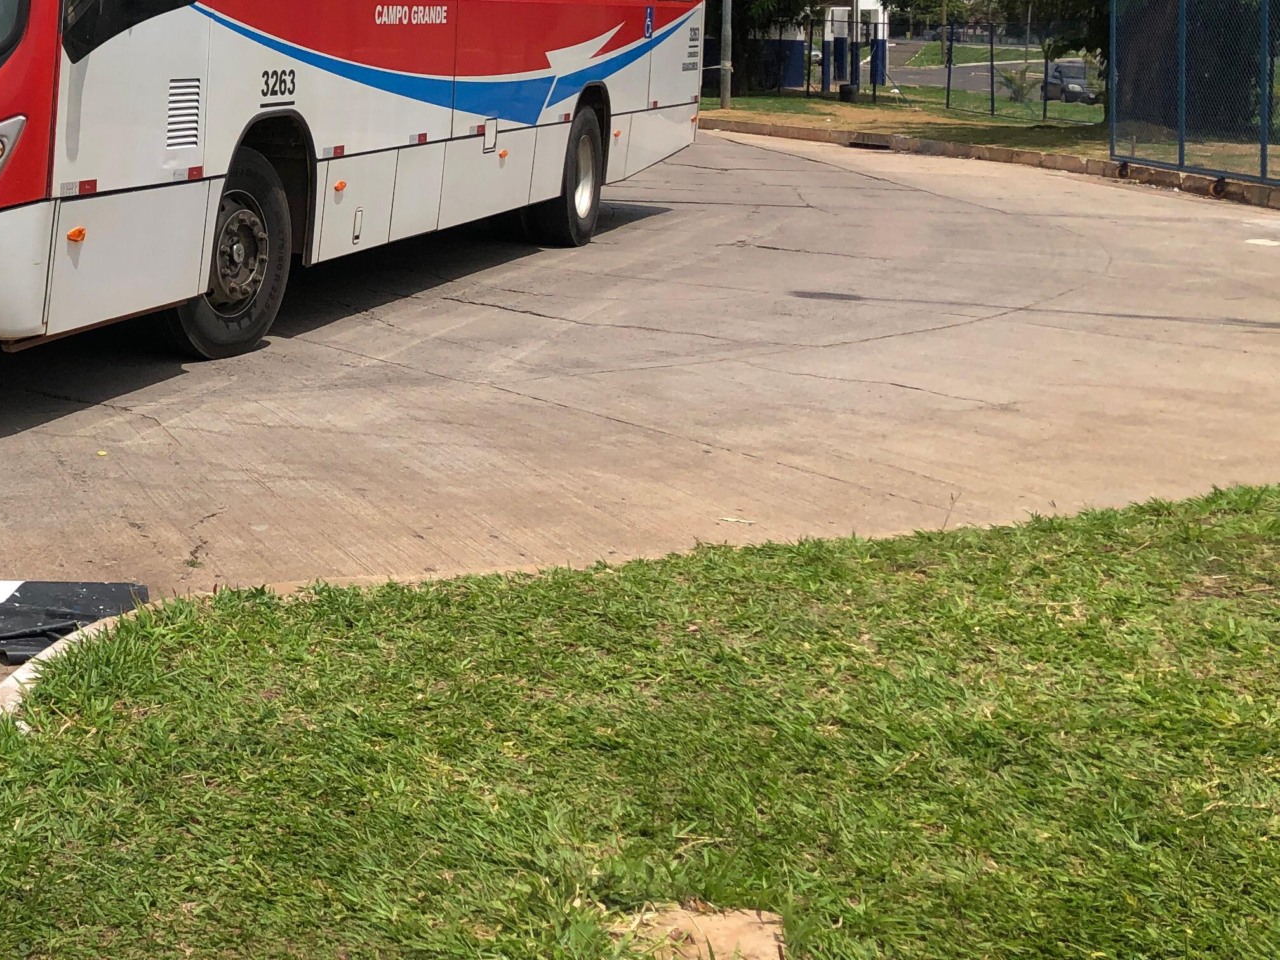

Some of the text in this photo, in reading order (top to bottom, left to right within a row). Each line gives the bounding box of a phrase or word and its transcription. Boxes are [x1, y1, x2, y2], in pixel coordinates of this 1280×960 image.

[375, 4, 448, 25] CAMPO GRANDE
[261, 69, 296, 97] 3263
